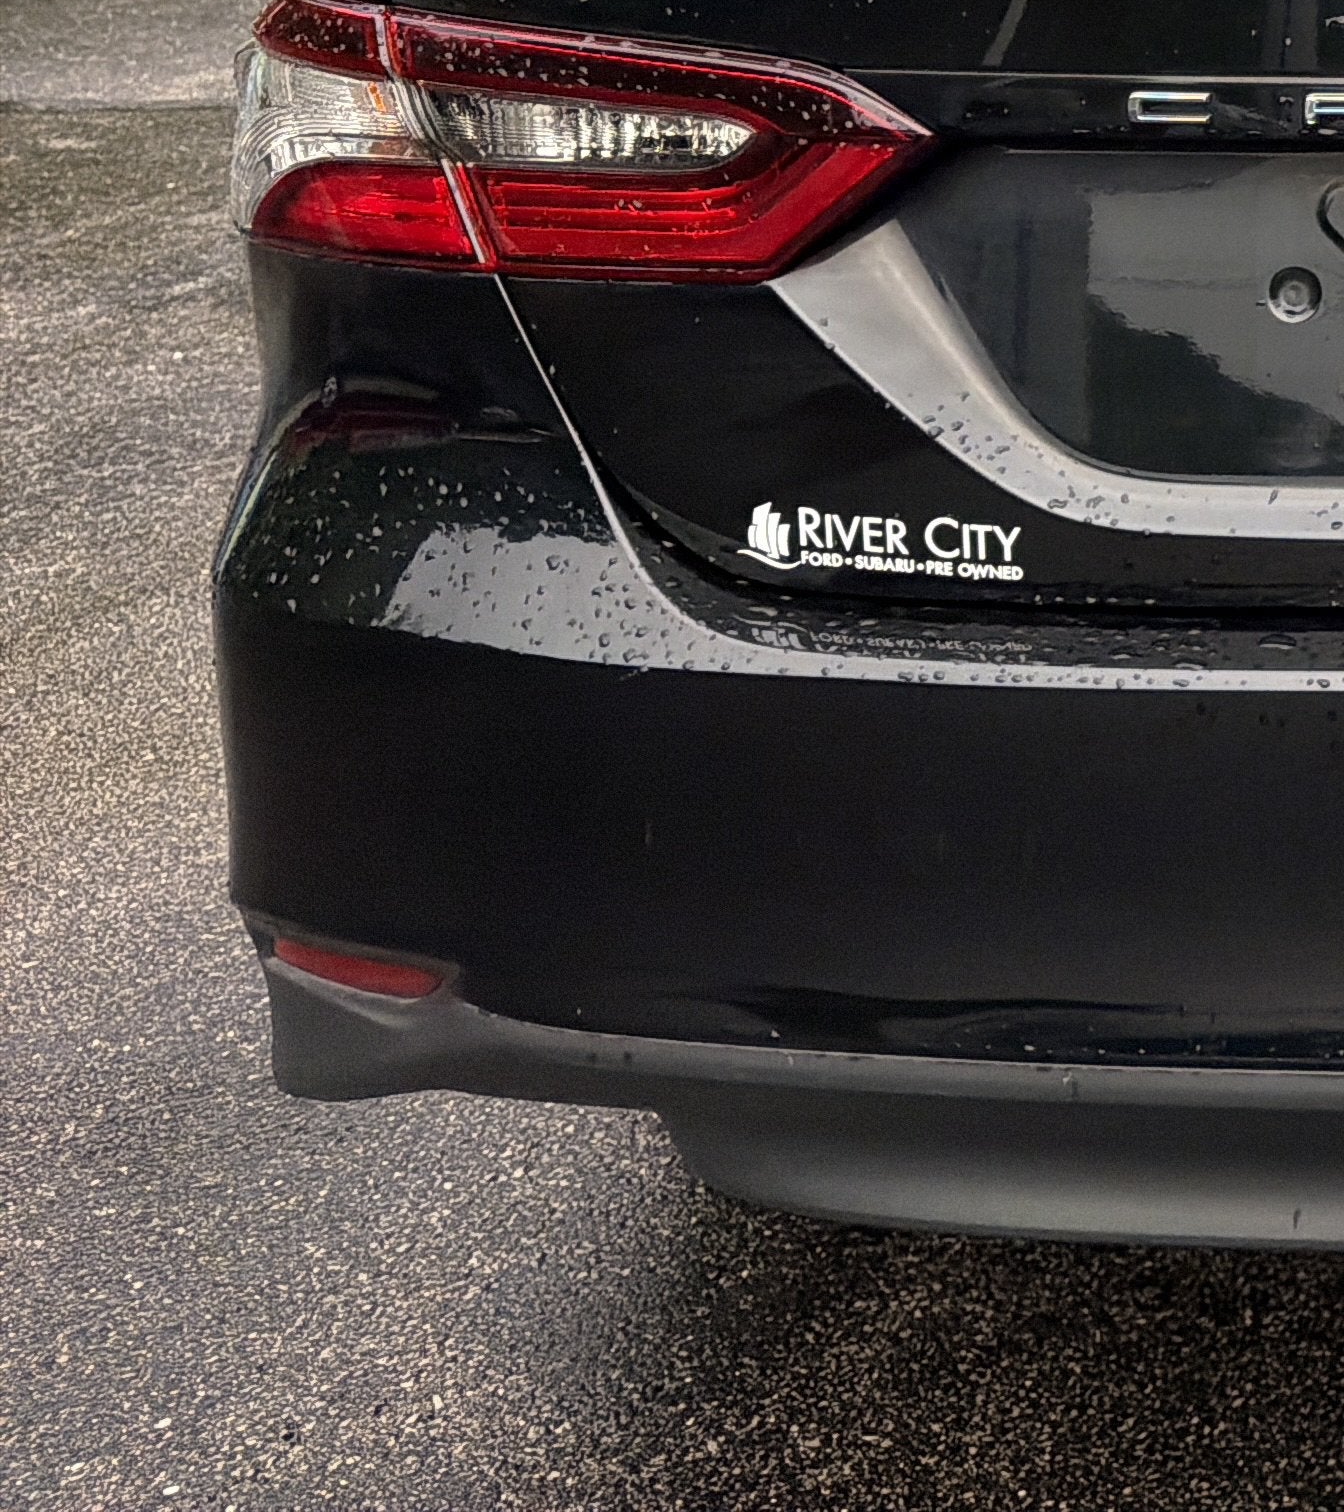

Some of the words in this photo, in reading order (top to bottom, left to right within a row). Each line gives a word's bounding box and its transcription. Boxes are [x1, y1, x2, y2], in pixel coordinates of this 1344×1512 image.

[798, 506, 910, 556] RIVER
[923, 516, 1022, 562] CITY
[801, 549, 844, 568] FORD
[854, 554, 916, 574] SUBARU
[925, 561, 954, 578] PRE
[957, 562, 1024, 581] OWNED
